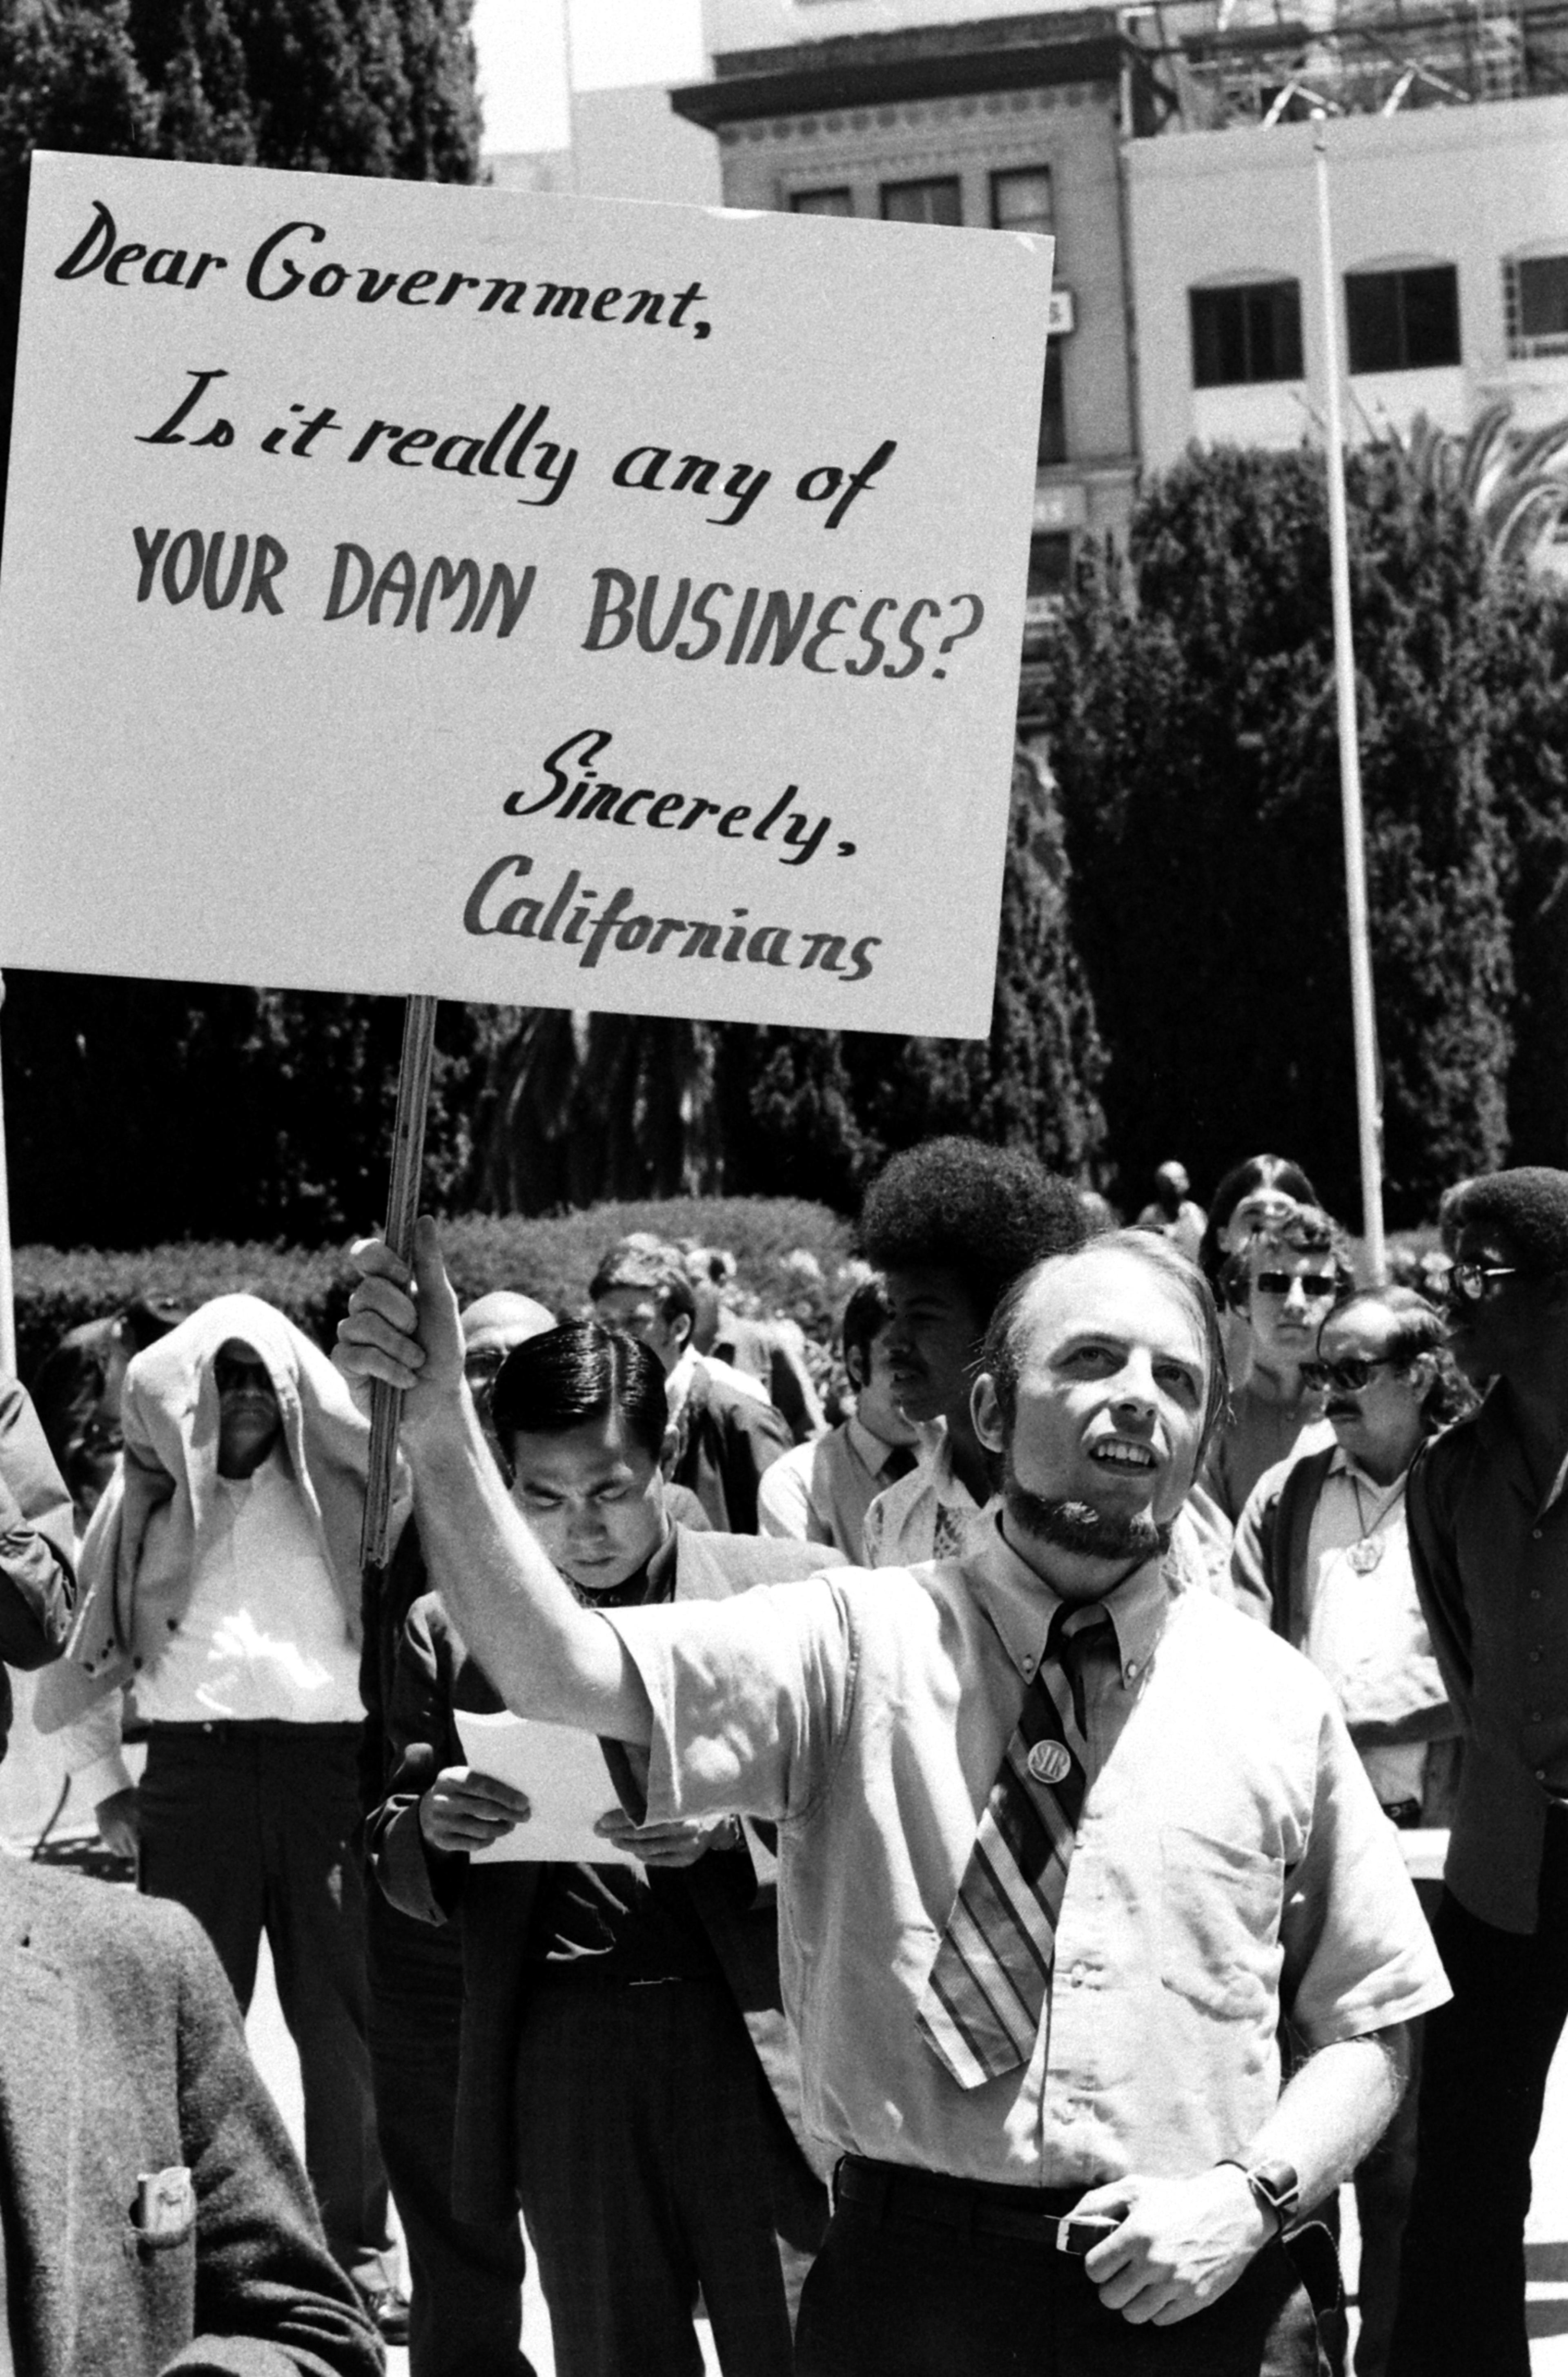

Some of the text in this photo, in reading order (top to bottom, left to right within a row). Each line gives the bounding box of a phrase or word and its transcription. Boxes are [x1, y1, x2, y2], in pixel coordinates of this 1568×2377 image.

[53, 199, 712, 340] Dear Government,
[134, 368, 898, 530] Is it really any of
[132, 526, 984, 680] YOUR DAMN BUSINESS?
[503, 729, 857, 867] Sincerely,
[463, 854, 882, 982] Californians
